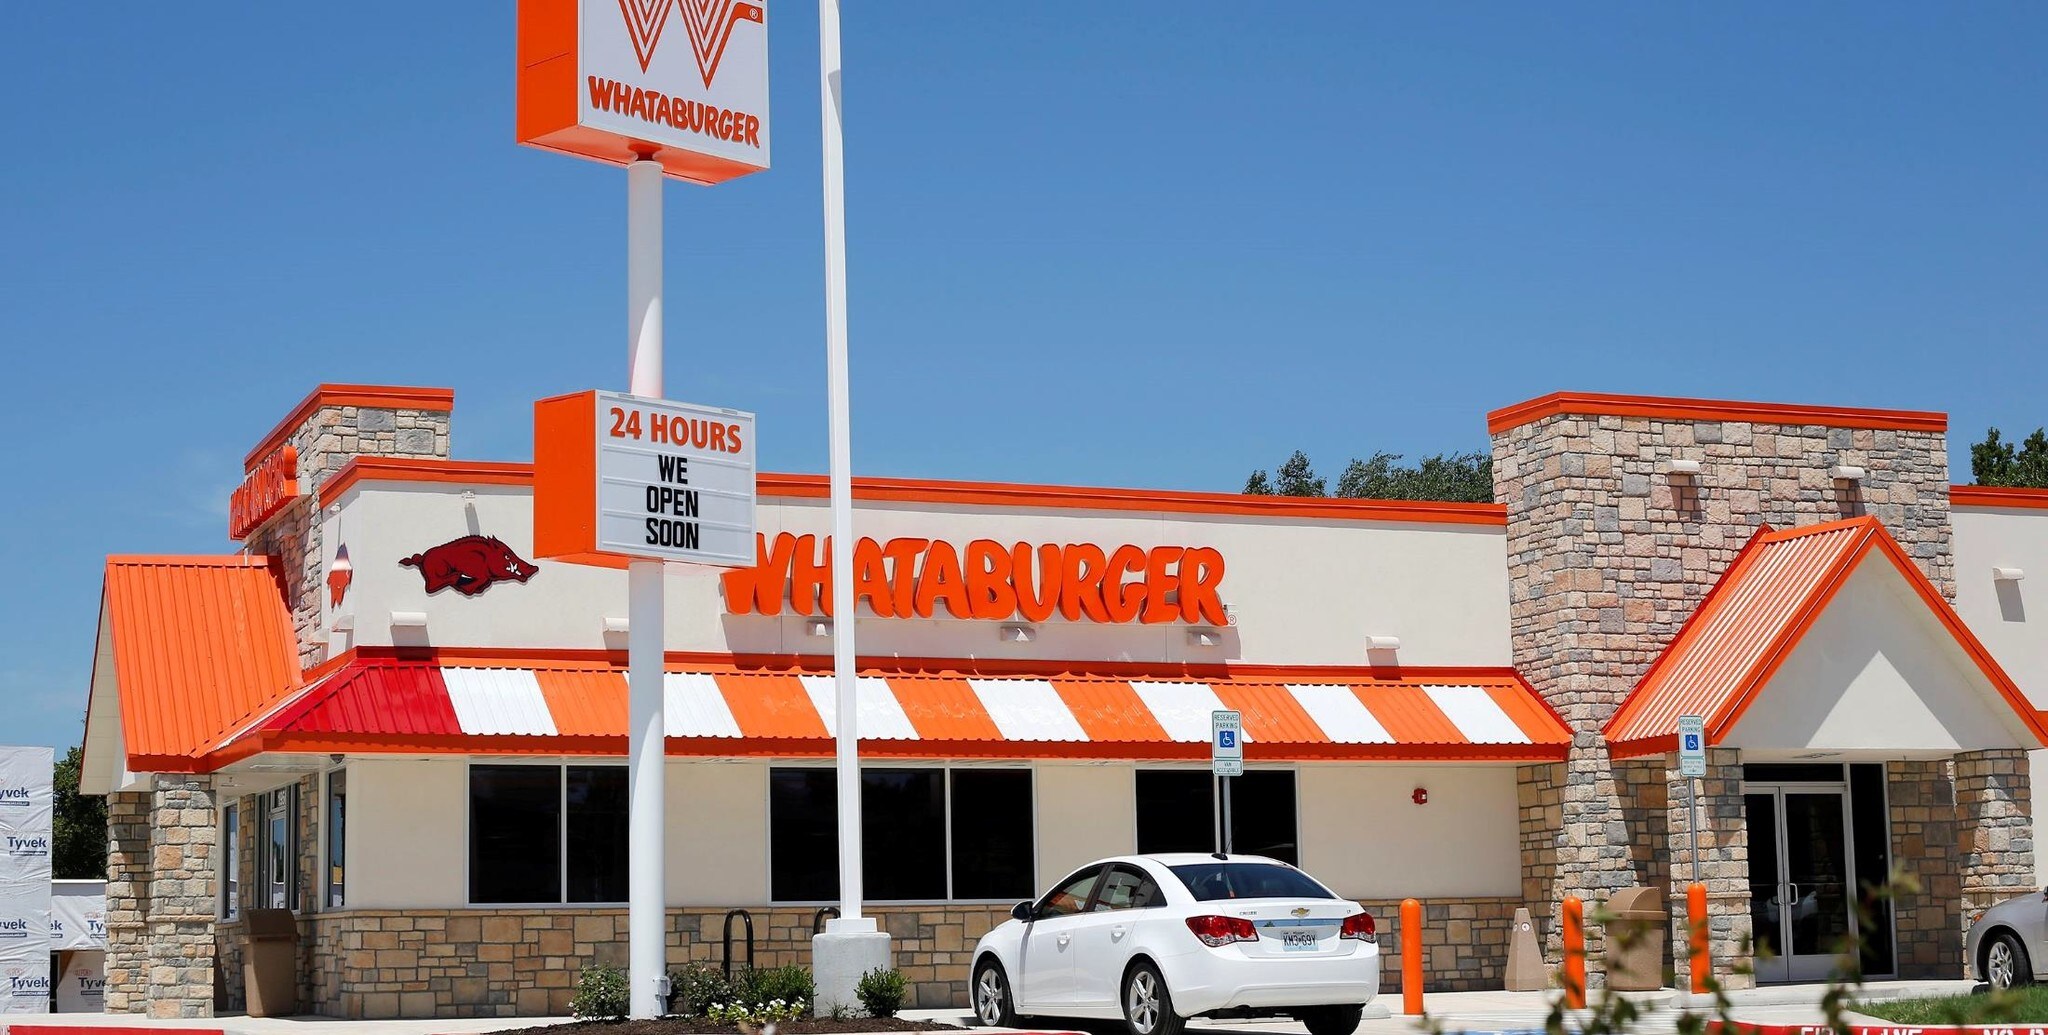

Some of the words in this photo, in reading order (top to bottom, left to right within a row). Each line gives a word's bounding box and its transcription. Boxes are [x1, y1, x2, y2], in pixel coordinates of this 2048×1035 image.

[588, 75, 760, 149] WHATABURGER
[610, 407, 642, 440] 24
[651, 413, 742, 454] HOURS
[658, 454, 688, 485] WE
[646, 485, 699, 518] OPEN
[646, 517, 699, 550] SOON
[721, 531, 1229, 626] WHATABURGER
[7, 836, 47, 850] Tyvek
[9, 976, 49, 990] Tyvek
